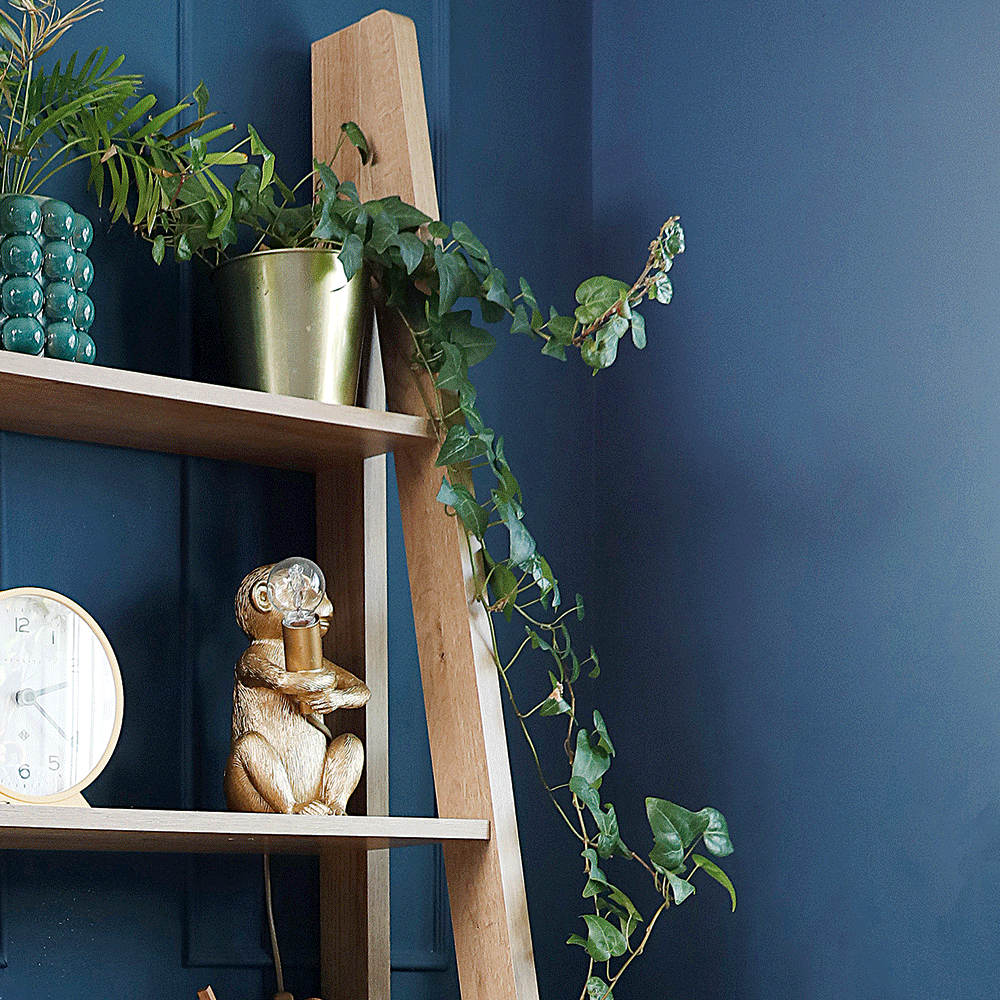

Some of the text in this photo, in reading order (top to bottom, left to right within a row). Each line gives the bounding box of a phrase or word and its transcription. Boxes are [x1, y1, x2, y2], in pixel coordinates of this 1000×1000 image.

[15, 617, 30, 633] 12
[48, 755, 60, 771] 5
[18, 764, 31, 780] 6
